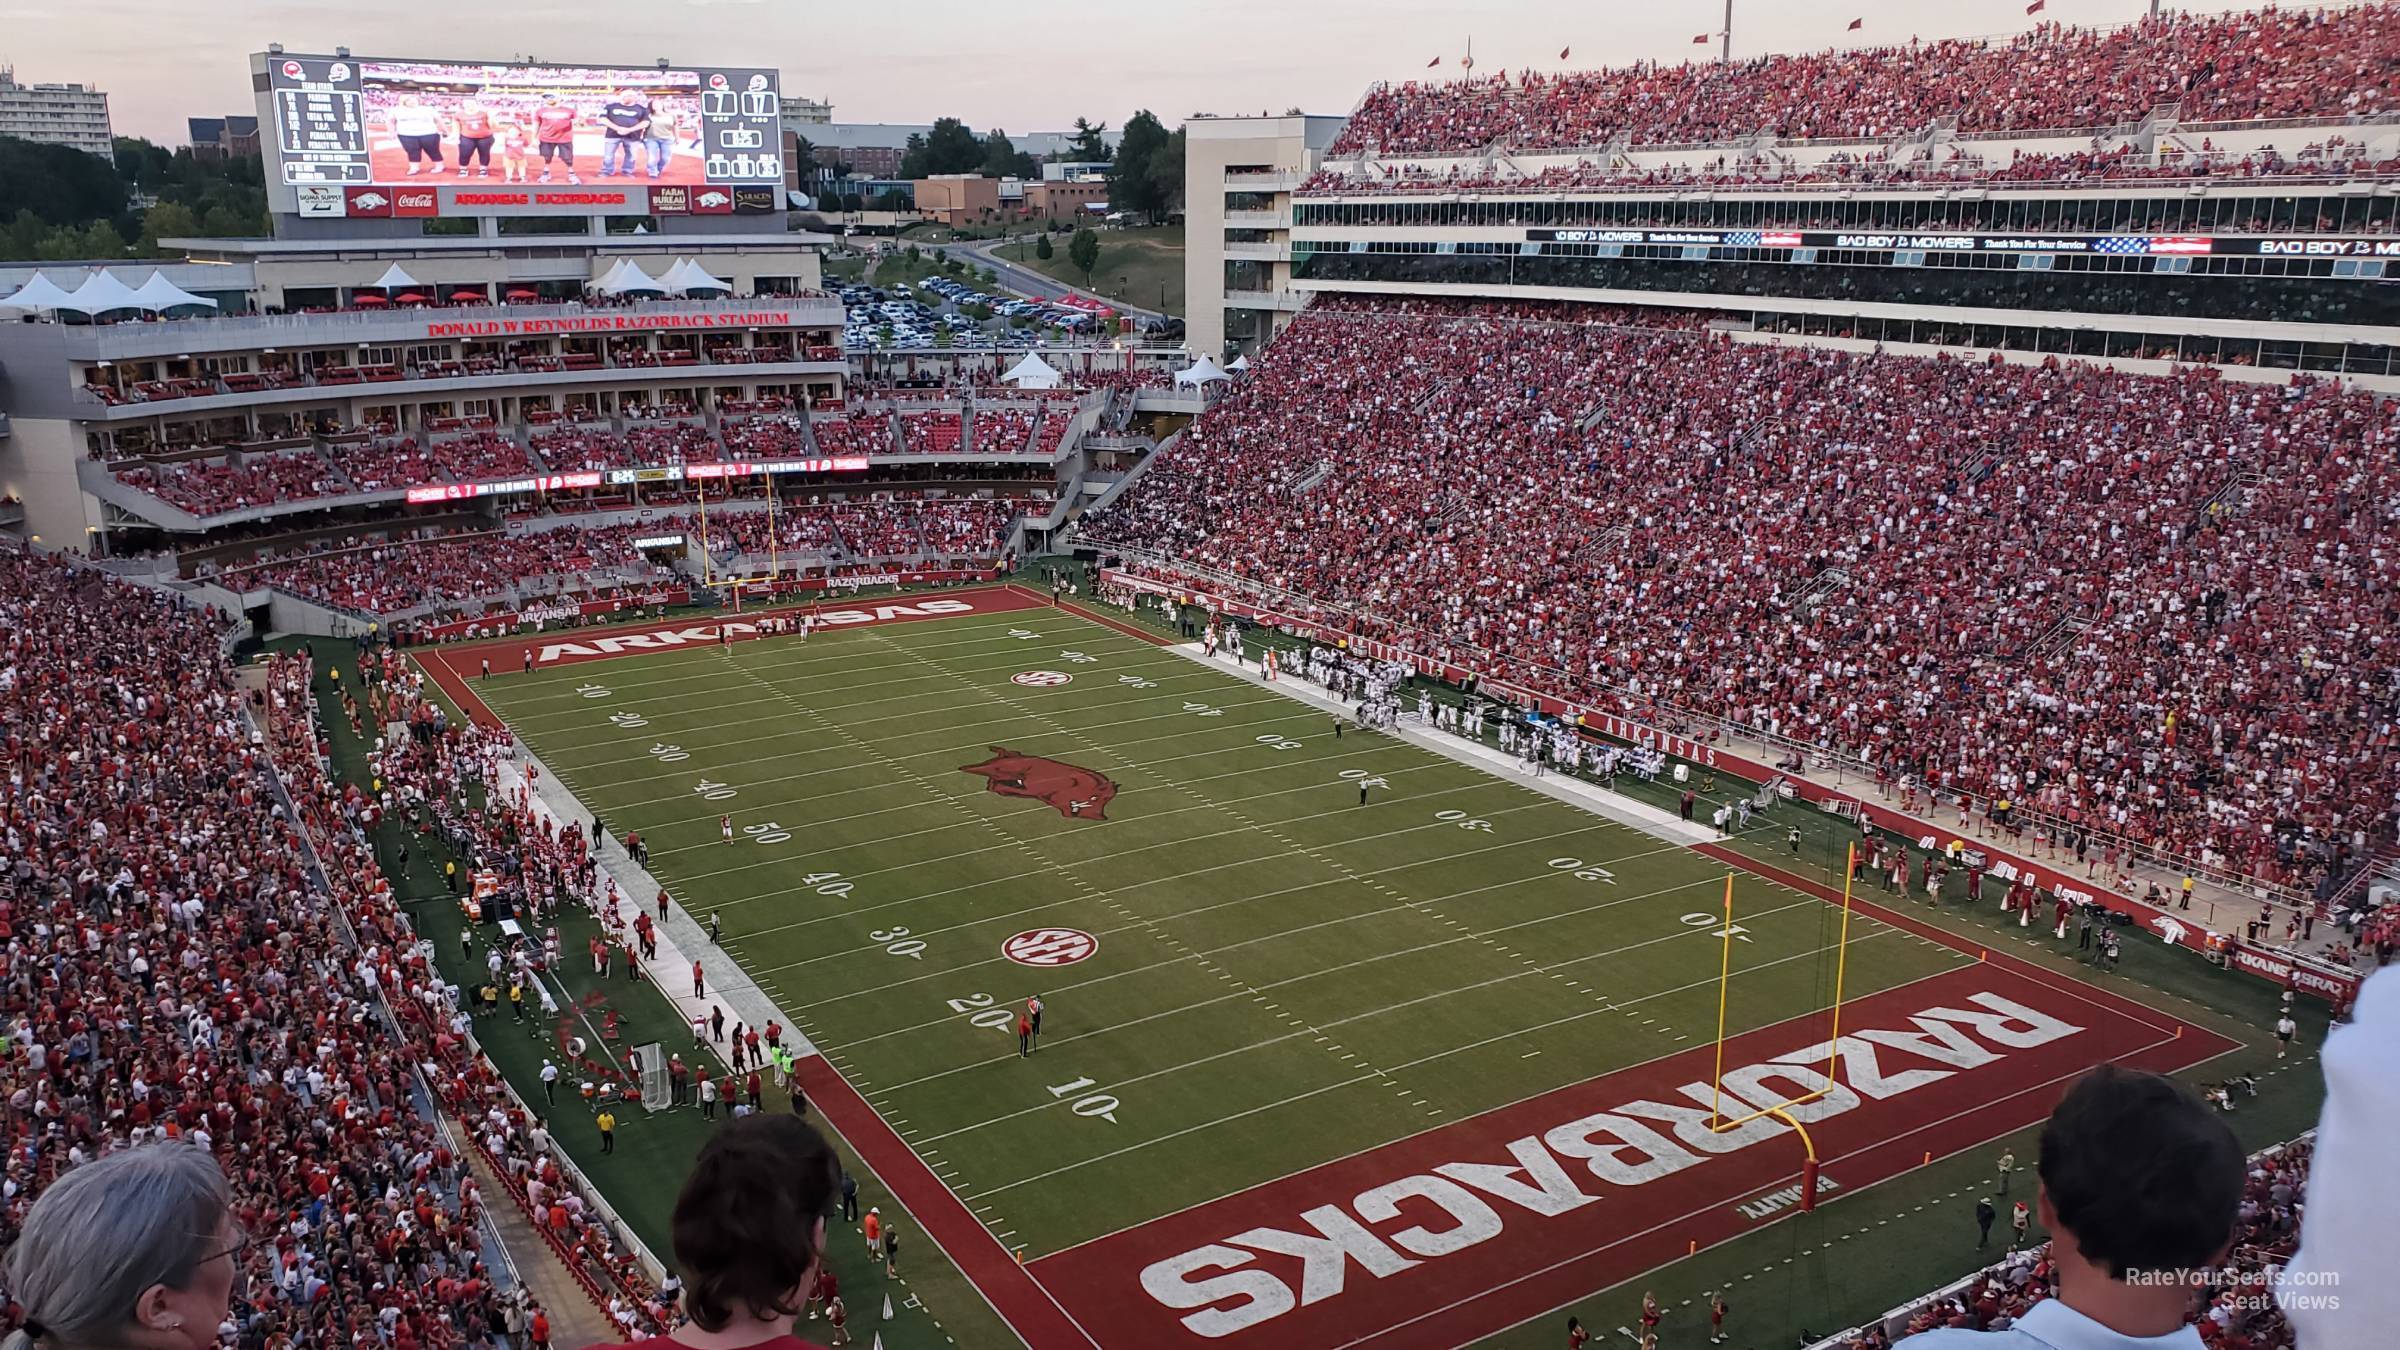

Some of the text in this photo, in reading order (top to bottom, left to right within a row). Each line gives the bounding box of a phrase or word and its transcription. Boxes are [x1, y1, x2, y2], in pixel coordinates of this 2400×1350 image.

[714, 92, 724, 113] 7
[398, 194, 433, 208] Coca-Cola
[454, 191, 626, 205] ARKANSAS RAZORBACKS
[652, 196, 686, 204] BUREAU
[661, 188, 685, 196] FARM
[736, 190, 771, 202] SARACEN
[1567, 231, 1588, 241] BOY
[1598, 231, 1644, 242] MOWERS
[1837, 235, 1975, 249] BAD BOY MOWERS
[1984, 239, 2086, 250] Thank You For Your Service
[2260, 241, 2303, 254] BAD
[2306, 241, 2351, 255] BOY
[428, 312, 790, 337] DONALD W REYNOLDS RAZORBACK STADIUM
[635, 535, 682, 548] ARKANSAS
[826, 574, 899, 588] RAZORBACKS
[517, 605, 580, 624] ARKANSAS
[576, 684, 612, 698] 10
[609, 712, 649, 728] 20
[1255, 734, 1303, 751] 50
[649, 743, 691, 762] 30
[693, 779, 738, 800] 40
[1434, 809, 1493, 833] 30
[743, 822, 792, 844] 50
[1547, 857, 1616, 886] 20
[802, 871, 855, 896] 40
[1680, 911, 1747, 942] 10
[869, 926, 928, 956] 30
[1009, 930, 1091, 964] SEC
[946, 991, 1015, 1028] 20
[1046, 1075, 1120, 1117] 10
[1139, 991, 2088, 1339] RAZORBACKS
